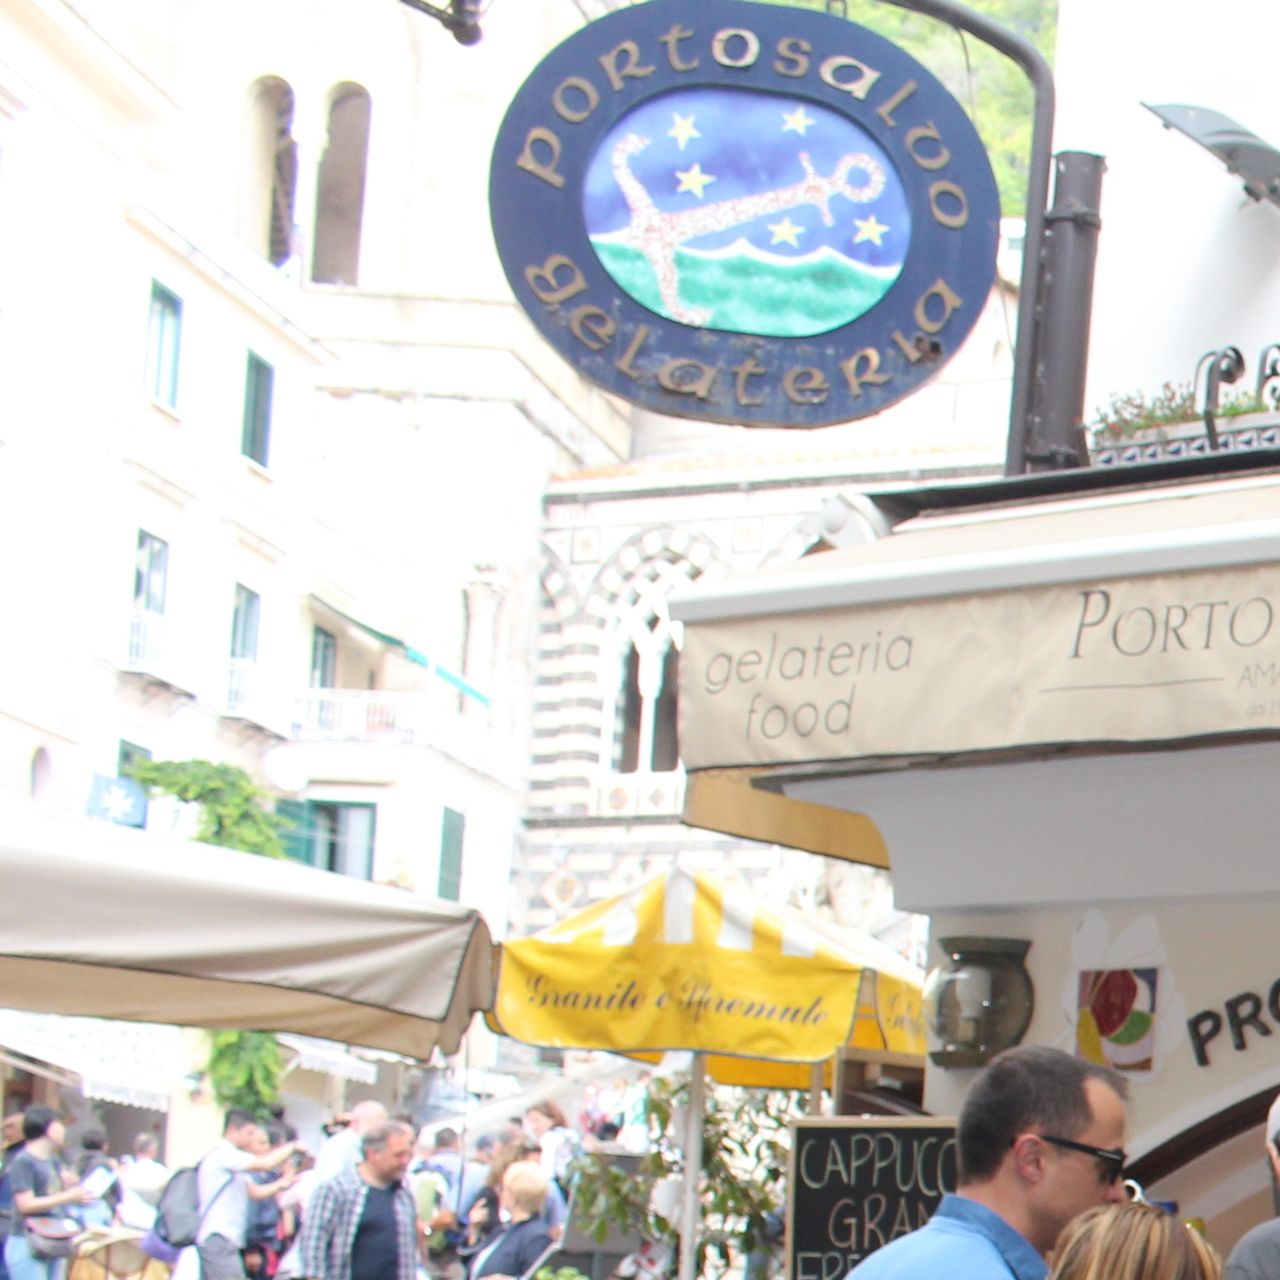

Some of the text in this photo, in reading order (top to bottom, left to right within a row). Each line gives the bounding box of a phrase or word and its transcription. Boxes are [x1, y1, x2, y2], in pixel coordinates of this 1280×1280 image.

[1069, 587, 1275, 660] PORTO
[704, 629, 914, 695] gelateria
[744, 684, 857, 741] food
[525, 973, 647, 1011] Granite
